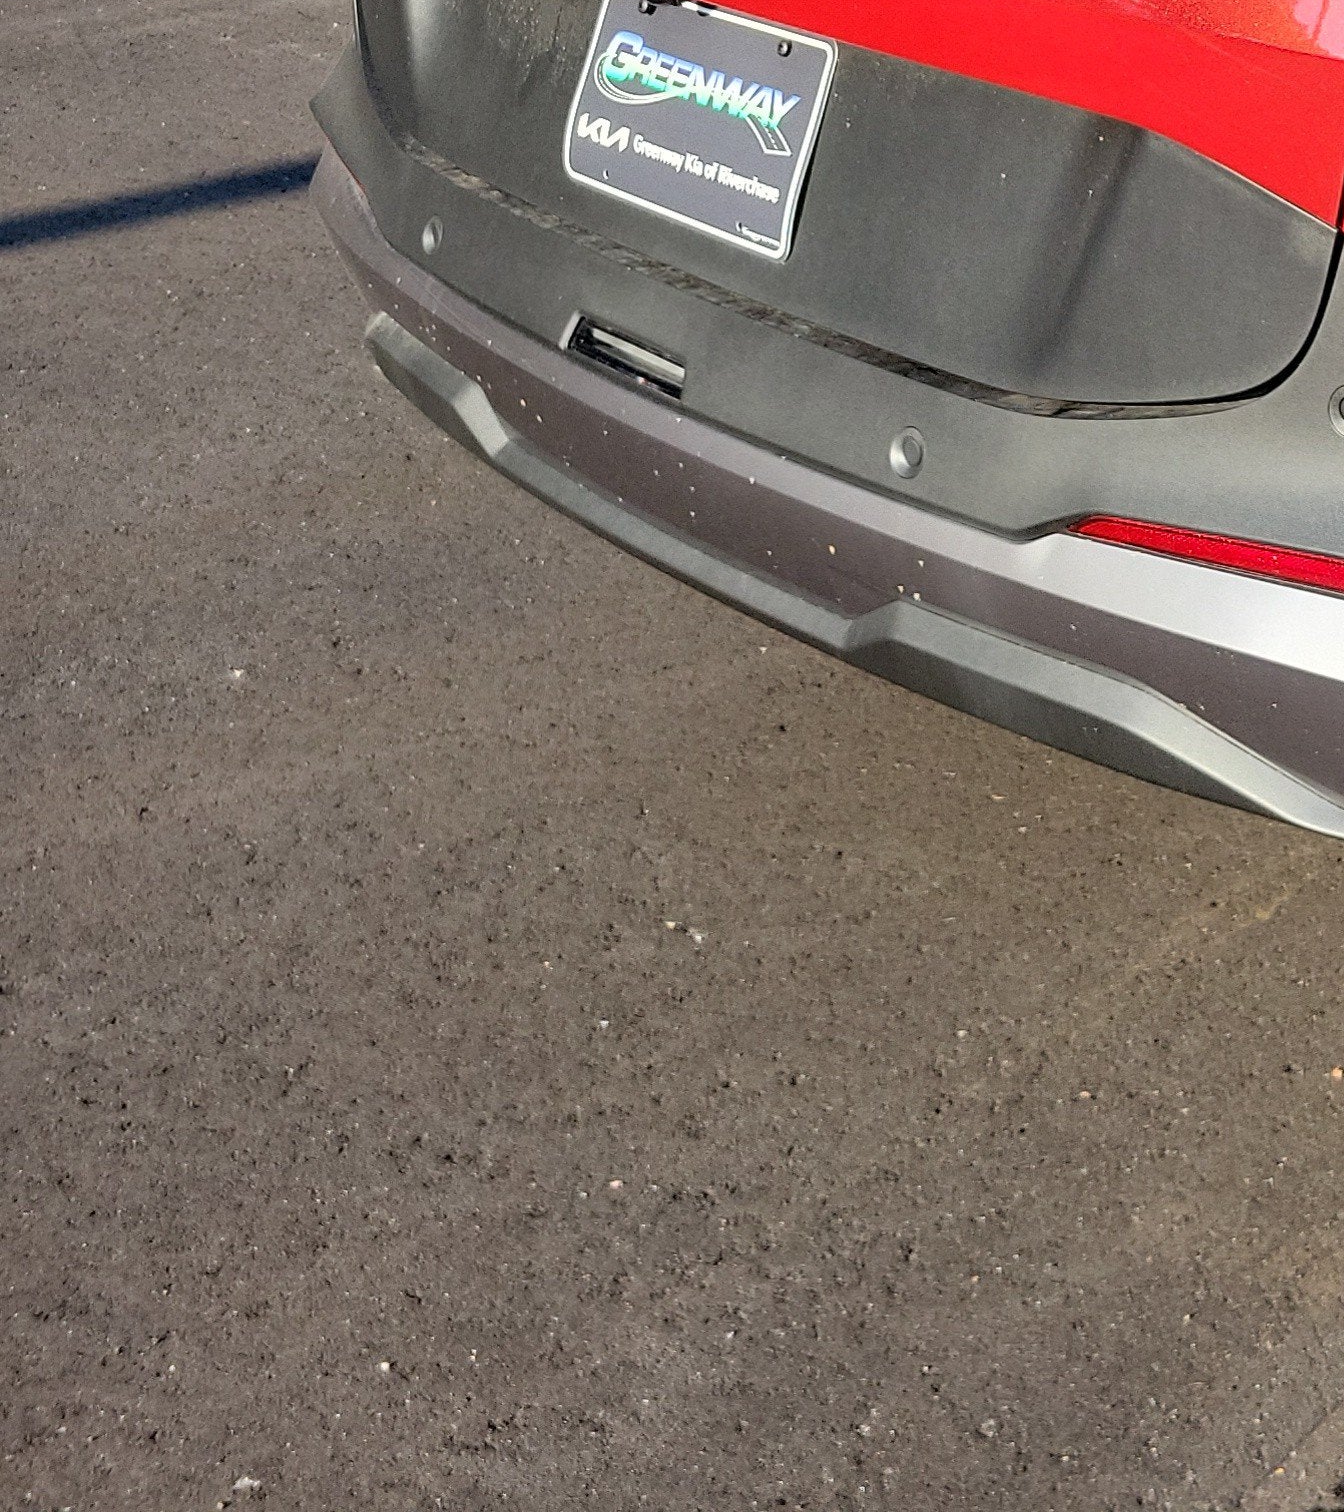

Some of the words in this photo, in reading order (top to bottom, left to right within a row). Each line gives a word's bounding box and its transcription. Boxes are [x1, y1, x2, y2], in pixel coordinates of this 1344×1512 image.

[601, 30, 801, 129] GREENWAY
[577, 112, 631, 152] KIA
[633, 134, 685, 173] Greenway
[685, 152, 703, 178] Kia
[704, 161, 717, 182] of
